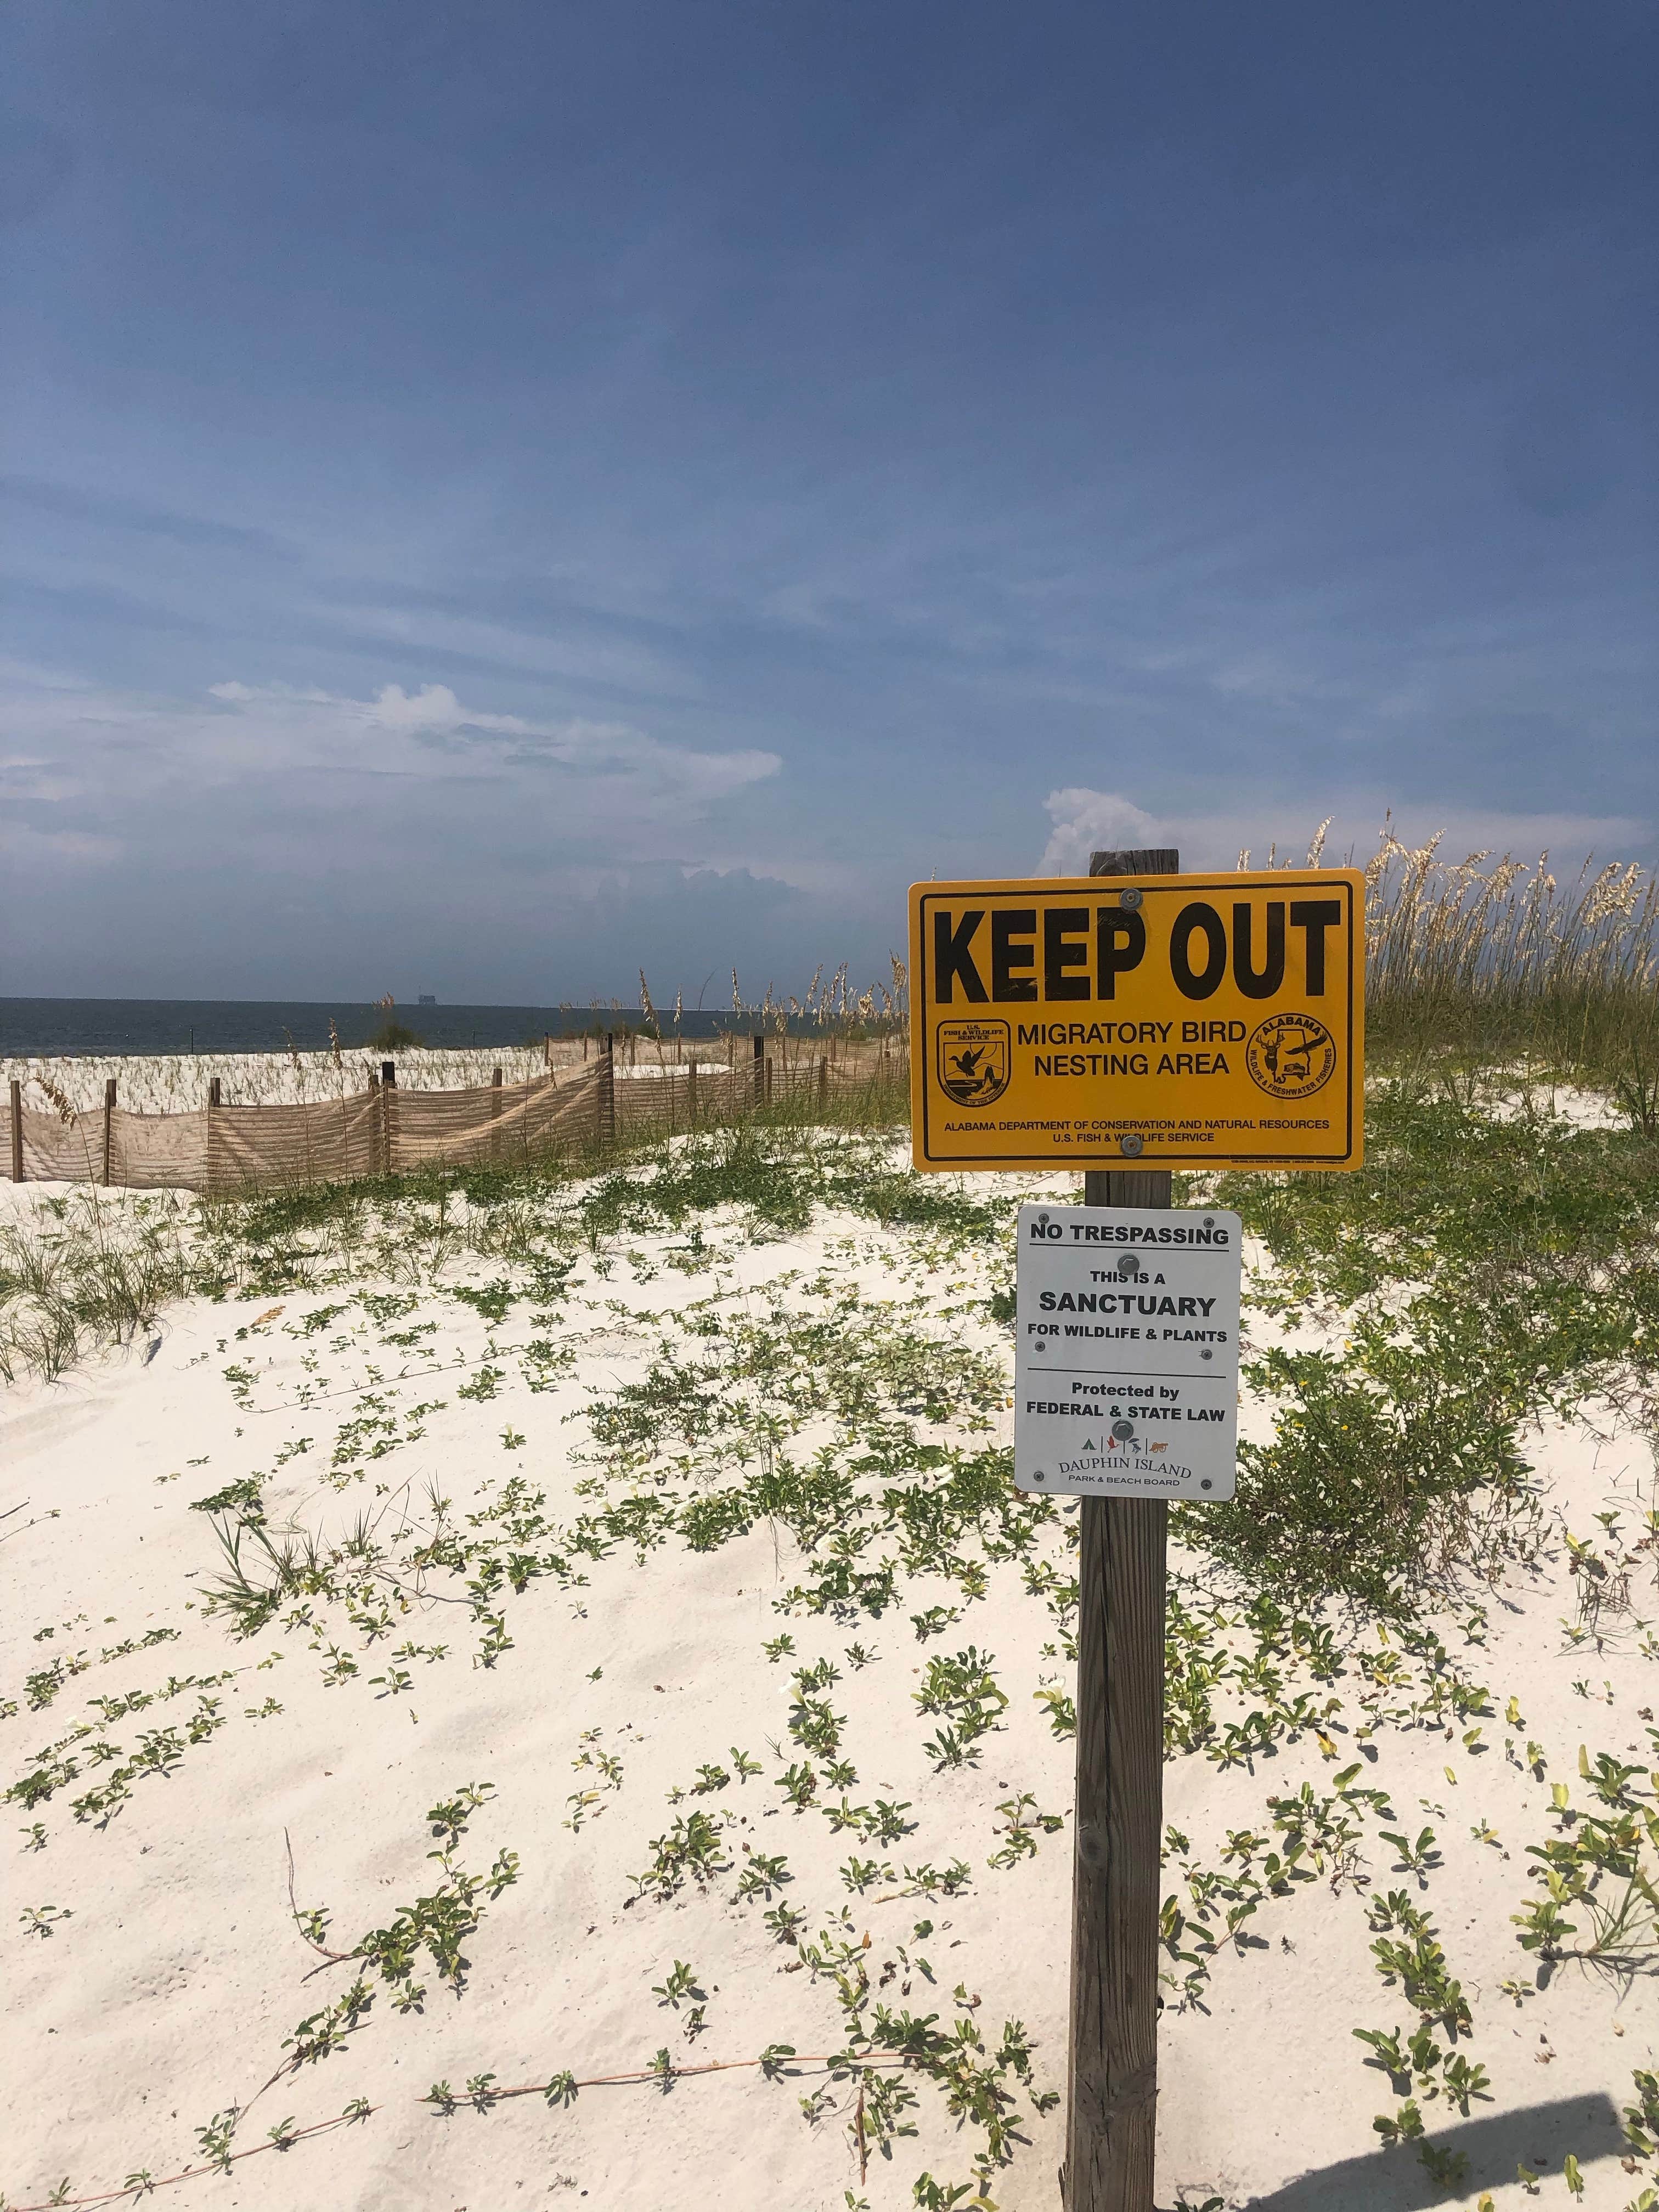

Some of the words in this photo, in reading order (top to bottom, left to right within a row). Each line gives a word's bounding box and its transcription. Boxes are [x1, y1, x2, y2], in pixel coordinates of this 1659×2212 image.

[934, 907, 1146, 1003] KEEP
[1169, 900, 1340, 1000] OUT
[1018, 1022, 1173, 1046] MIGRATORY
[1181, 1020, 1246, 1043] BIRD
[1262, 1017, 1321, 1036] ALABAMA
[1035, 1054, 1148, 1076] NESTING
[1156, 1053, 1229, 1075] AREA
[1250, 1049, 1264, 1081] WILDLIFE
[1267, 1082, 1316, 1095] FRESHWATER
[1316, 1048, 1331, 1083] FISHERIES
[945, 1122, 996, 1131] ALABAMA
[999, 1121, 1070, 1131] DEPARTMENT
[1074, 1121, 1088, 1130] OF
[1091, 1120, 1175, 1130] CONSERVATION
[1178, 1120, 1202, 1129] AND
[1205, 1120, 1256, 1128] NATURAL
[1260, 1120, 1329, 1129] RESOURCES
[1053, 1134, 1073, 1142] U.S.
[1077, 1133, 1101, 1142] FISH
[1104, 1133, 1111, 1142] &
[1168, 1133, 1214, 1142] SERVICE
[1031, 1223, 1063, 1240] NO
[1070, 1224, 1228, 1244] TRESPASSING
[1090, 1271, 1128, 1283] THIS
[1133, 1272, 1149, 1284] IS
[1154, 1273, 1165, 1284] A
[1039, 1291, 1216, 1317] SANCTUARY
[1028, 1323, 1059, 1336] FOR
[1064, 1325, 1140, 1339] WILDLIFE
[1146, 1328, 1157, 1340] &
[1163, 1329, 1227, 1342] PLANTS
[1072, 1383, 1154, 1398] Protected
[1160, 1386, 1179, 1401] by
[1026, 1402, 1103, 1417] FEDERAL
[1109, 1406, 1121, 1417] &
[1127, 1407, 1182, 1419] STATE
[1187, 1408, 1225, 1421] LAW
[1058, 1457, 1130, 1473] DAUPHIN
[1135, 1458, 1192, 1479] ISLAND
